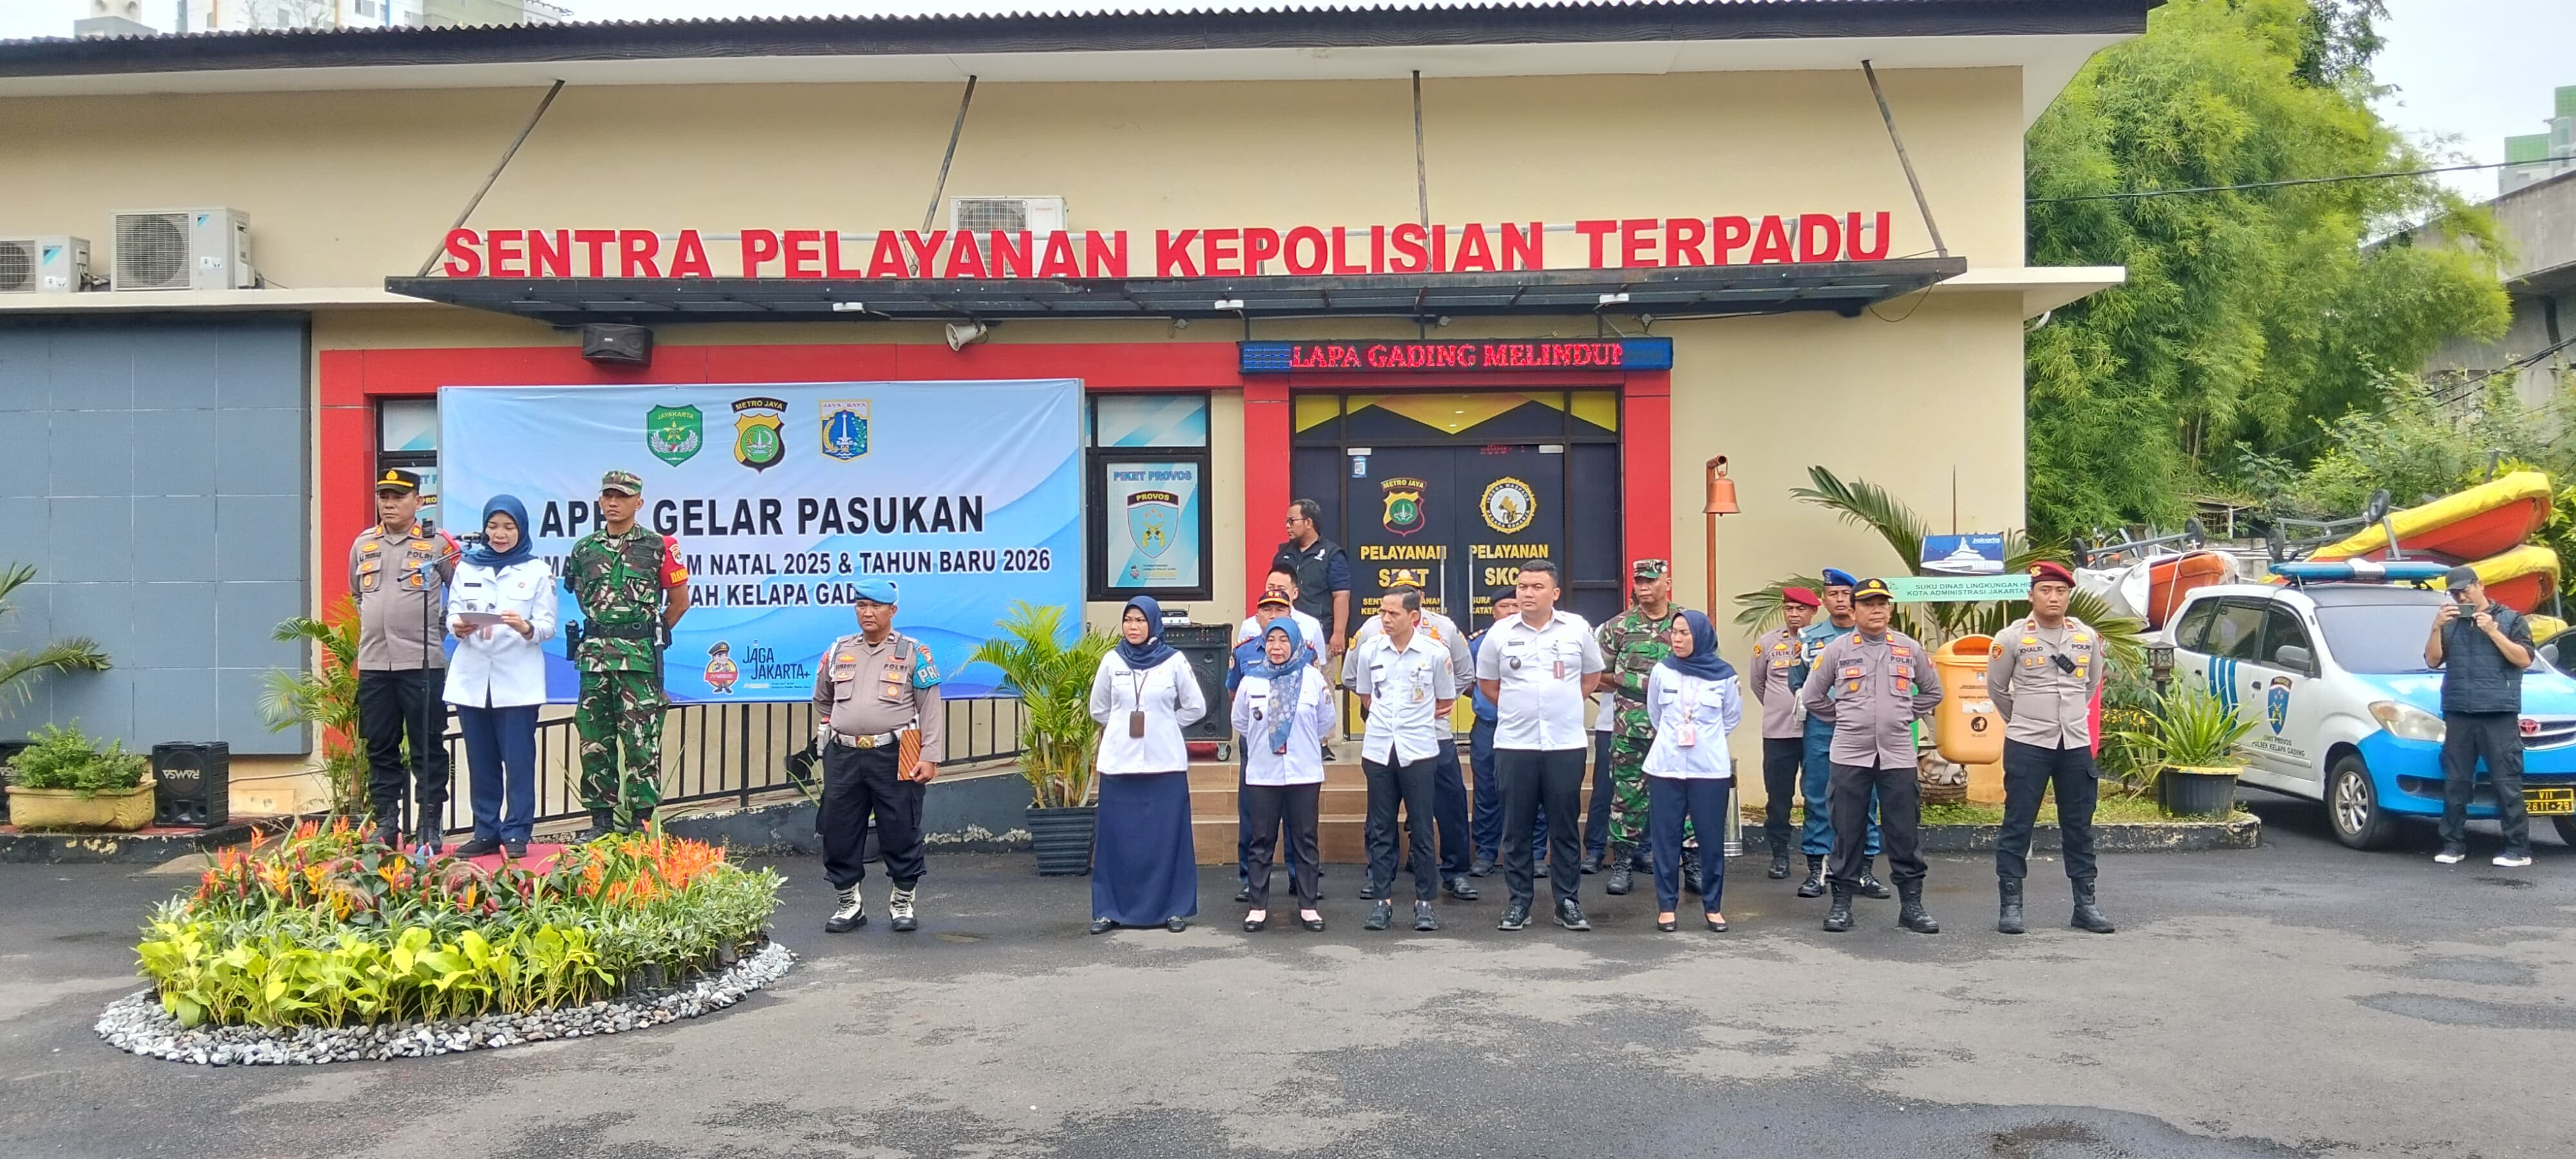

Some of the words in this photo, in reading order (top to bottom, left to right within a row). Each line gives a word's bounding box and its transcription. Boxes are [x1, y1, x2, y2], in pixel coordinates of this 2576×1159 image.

[443, 229, 714, 278] SENTRA
[740, 229, 1128, 278] PELAYANAN
[1155, 221, 1543, 277] KEPOLISIAN
[1575, 212, 1890, 269] TERPADU
[1290, 344, 1361, 368] LAPA
[1368, 344, 1475, 367] GADING
[735, 400, 762, 410] METRO
[763, 401, 783, 410] JAYA
[657, 411, 694, 420] JAYAKARTA
[1113, 471, 1146, 481] PIKET
[1148, 471, 1192, 481] PROVOS
[1383, 480, 1407, 489] METRO
[1408, 480, 1425, 489] JAYA
[539, 501, 607, 538] AP
[652, 498, 784, 536] GELAR
[798, 495, 983, 534] PASUKAN
[406, 551, 433, 560] POLRI
[710, 553, 777, 575] NATAL
[784, 552, 831, 574] 2025
[838, 552, 852, 574] &
[859, 551, 931, 573] TAHUN
[940, 549, 996, 572] BARU
[1003, 549, 1050, 571] 2026
[1379, 569, 1429, 587] ST
[1485, 567, 1519, 585] SKC
[727, 584, 808, 606] KELAPA
[743, 646, 774, 664] JAGA
[1891, 656, 1913, 665] POLRI
[162, 769, 200, 779] RAMSA
